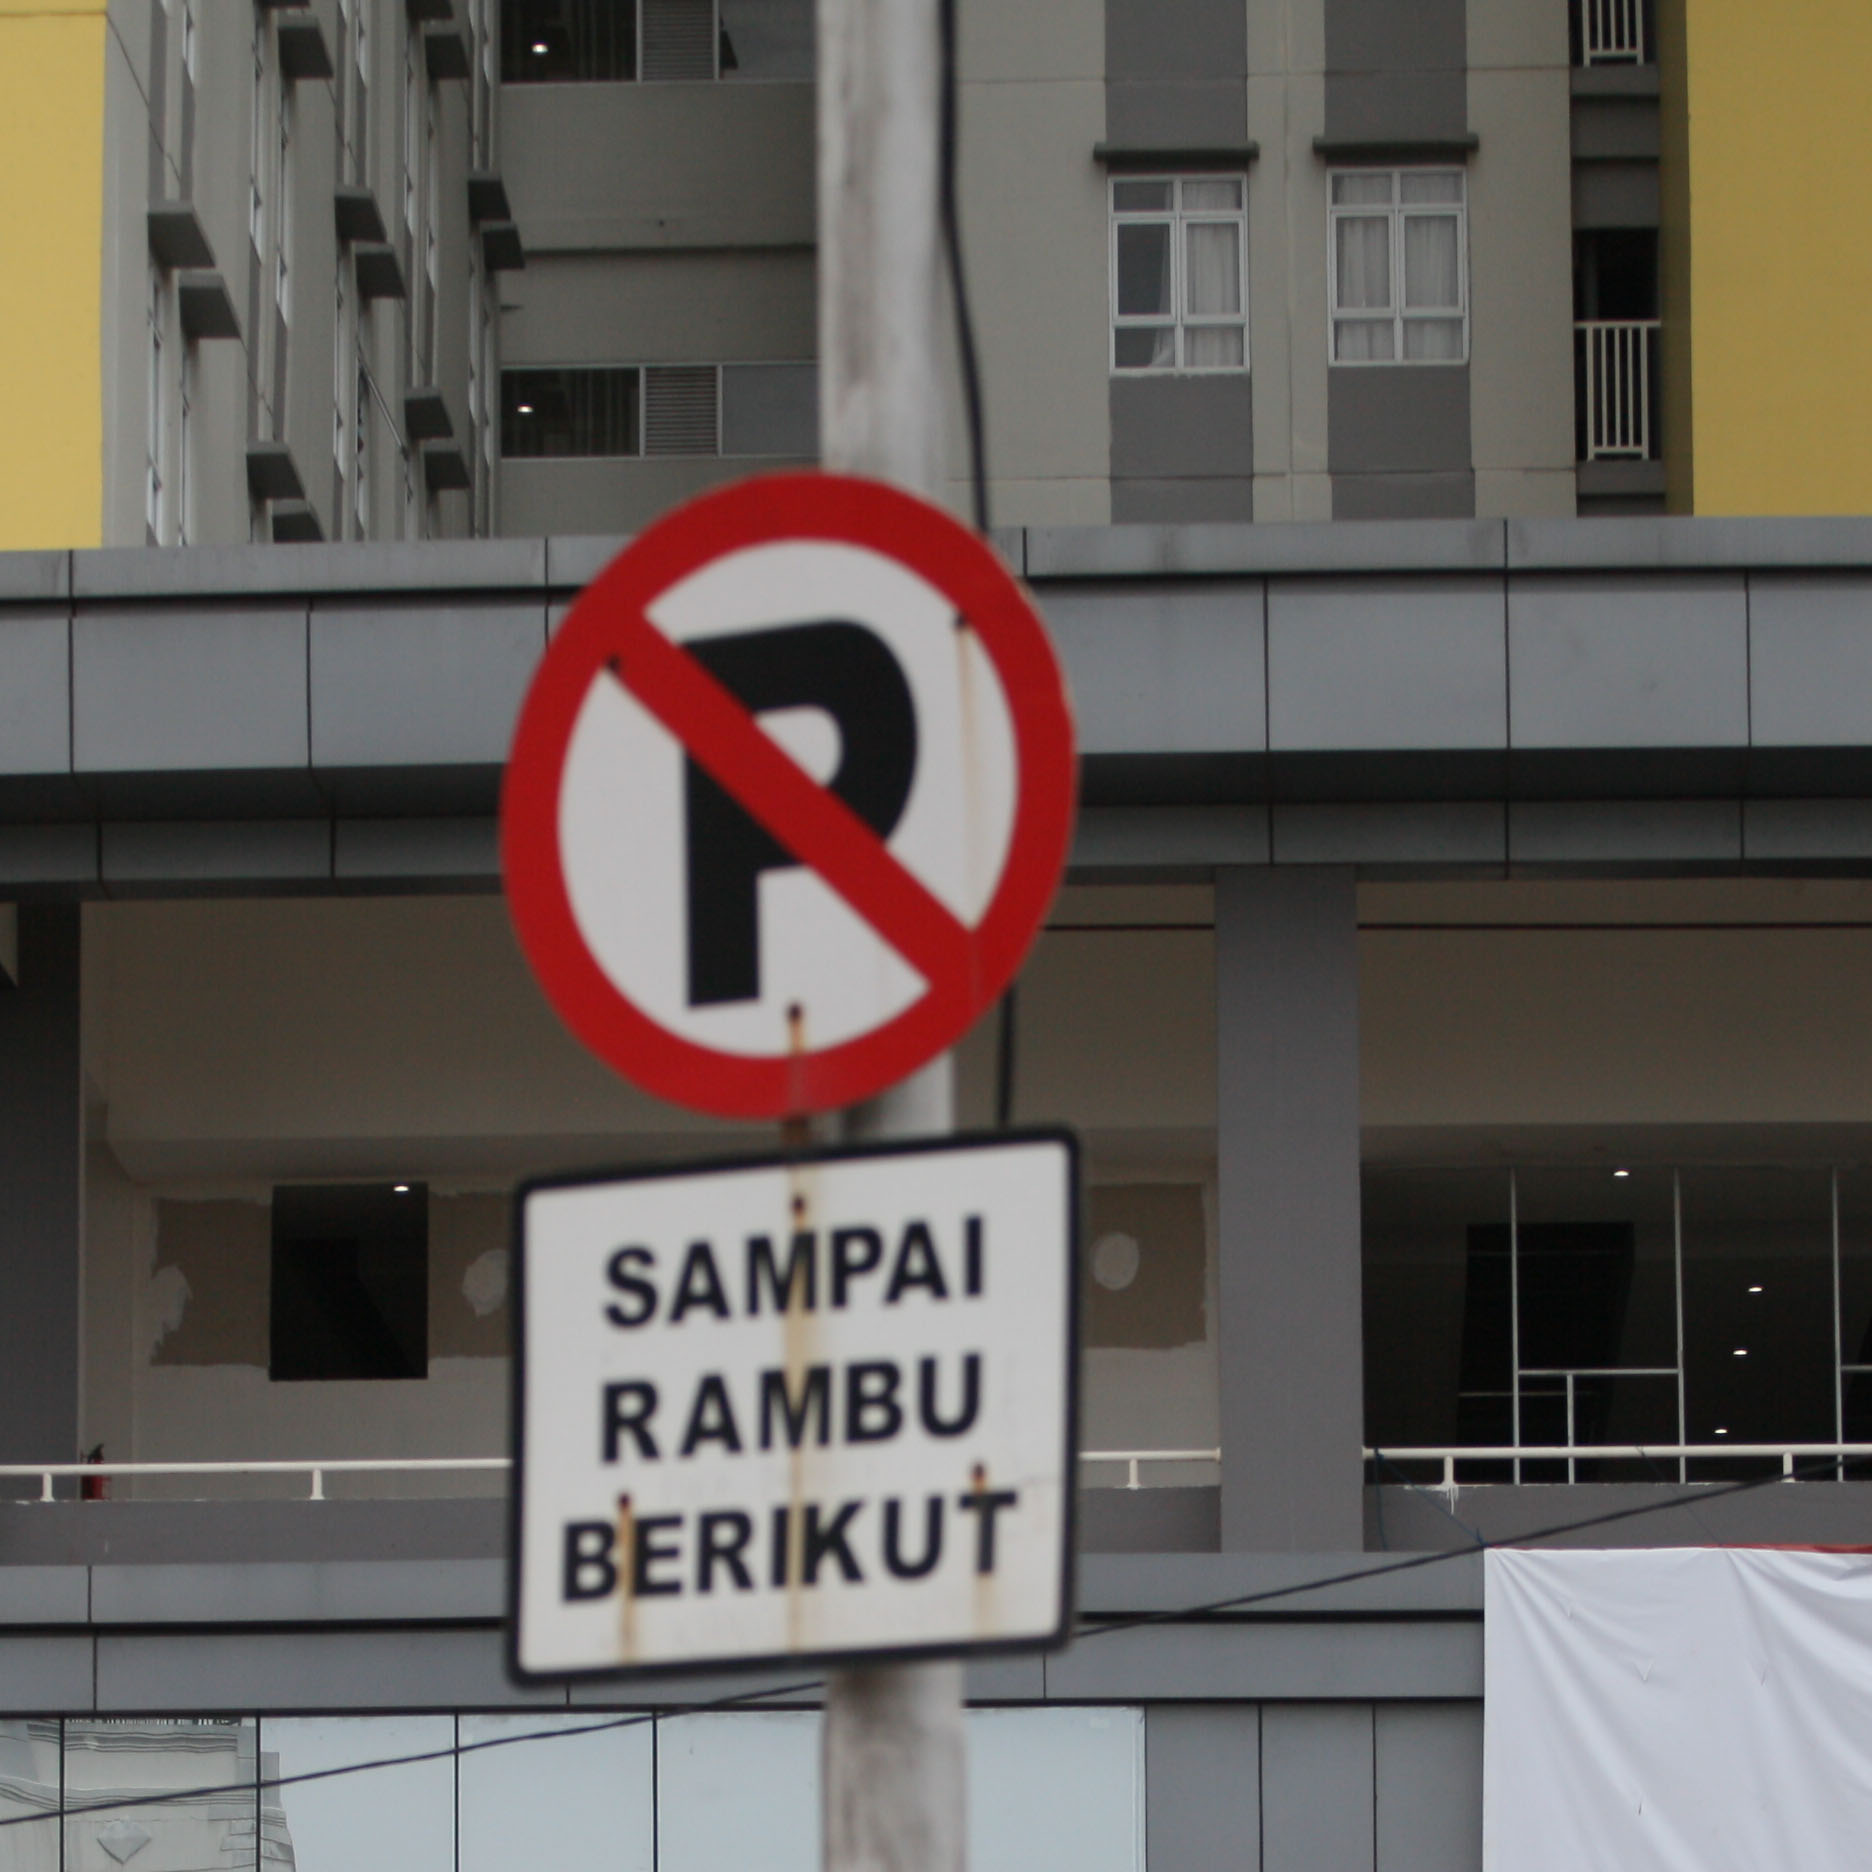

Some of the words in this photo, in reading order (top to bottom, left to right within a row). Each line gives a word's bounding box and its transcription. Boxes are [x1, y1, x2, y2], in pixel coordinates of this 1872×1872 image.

[604, 1216, 984, 1330] SAMPAI
[601, 1353, 983, 1464] RAMBU
[562, 1490, 1018, 1603] BERIKUT
